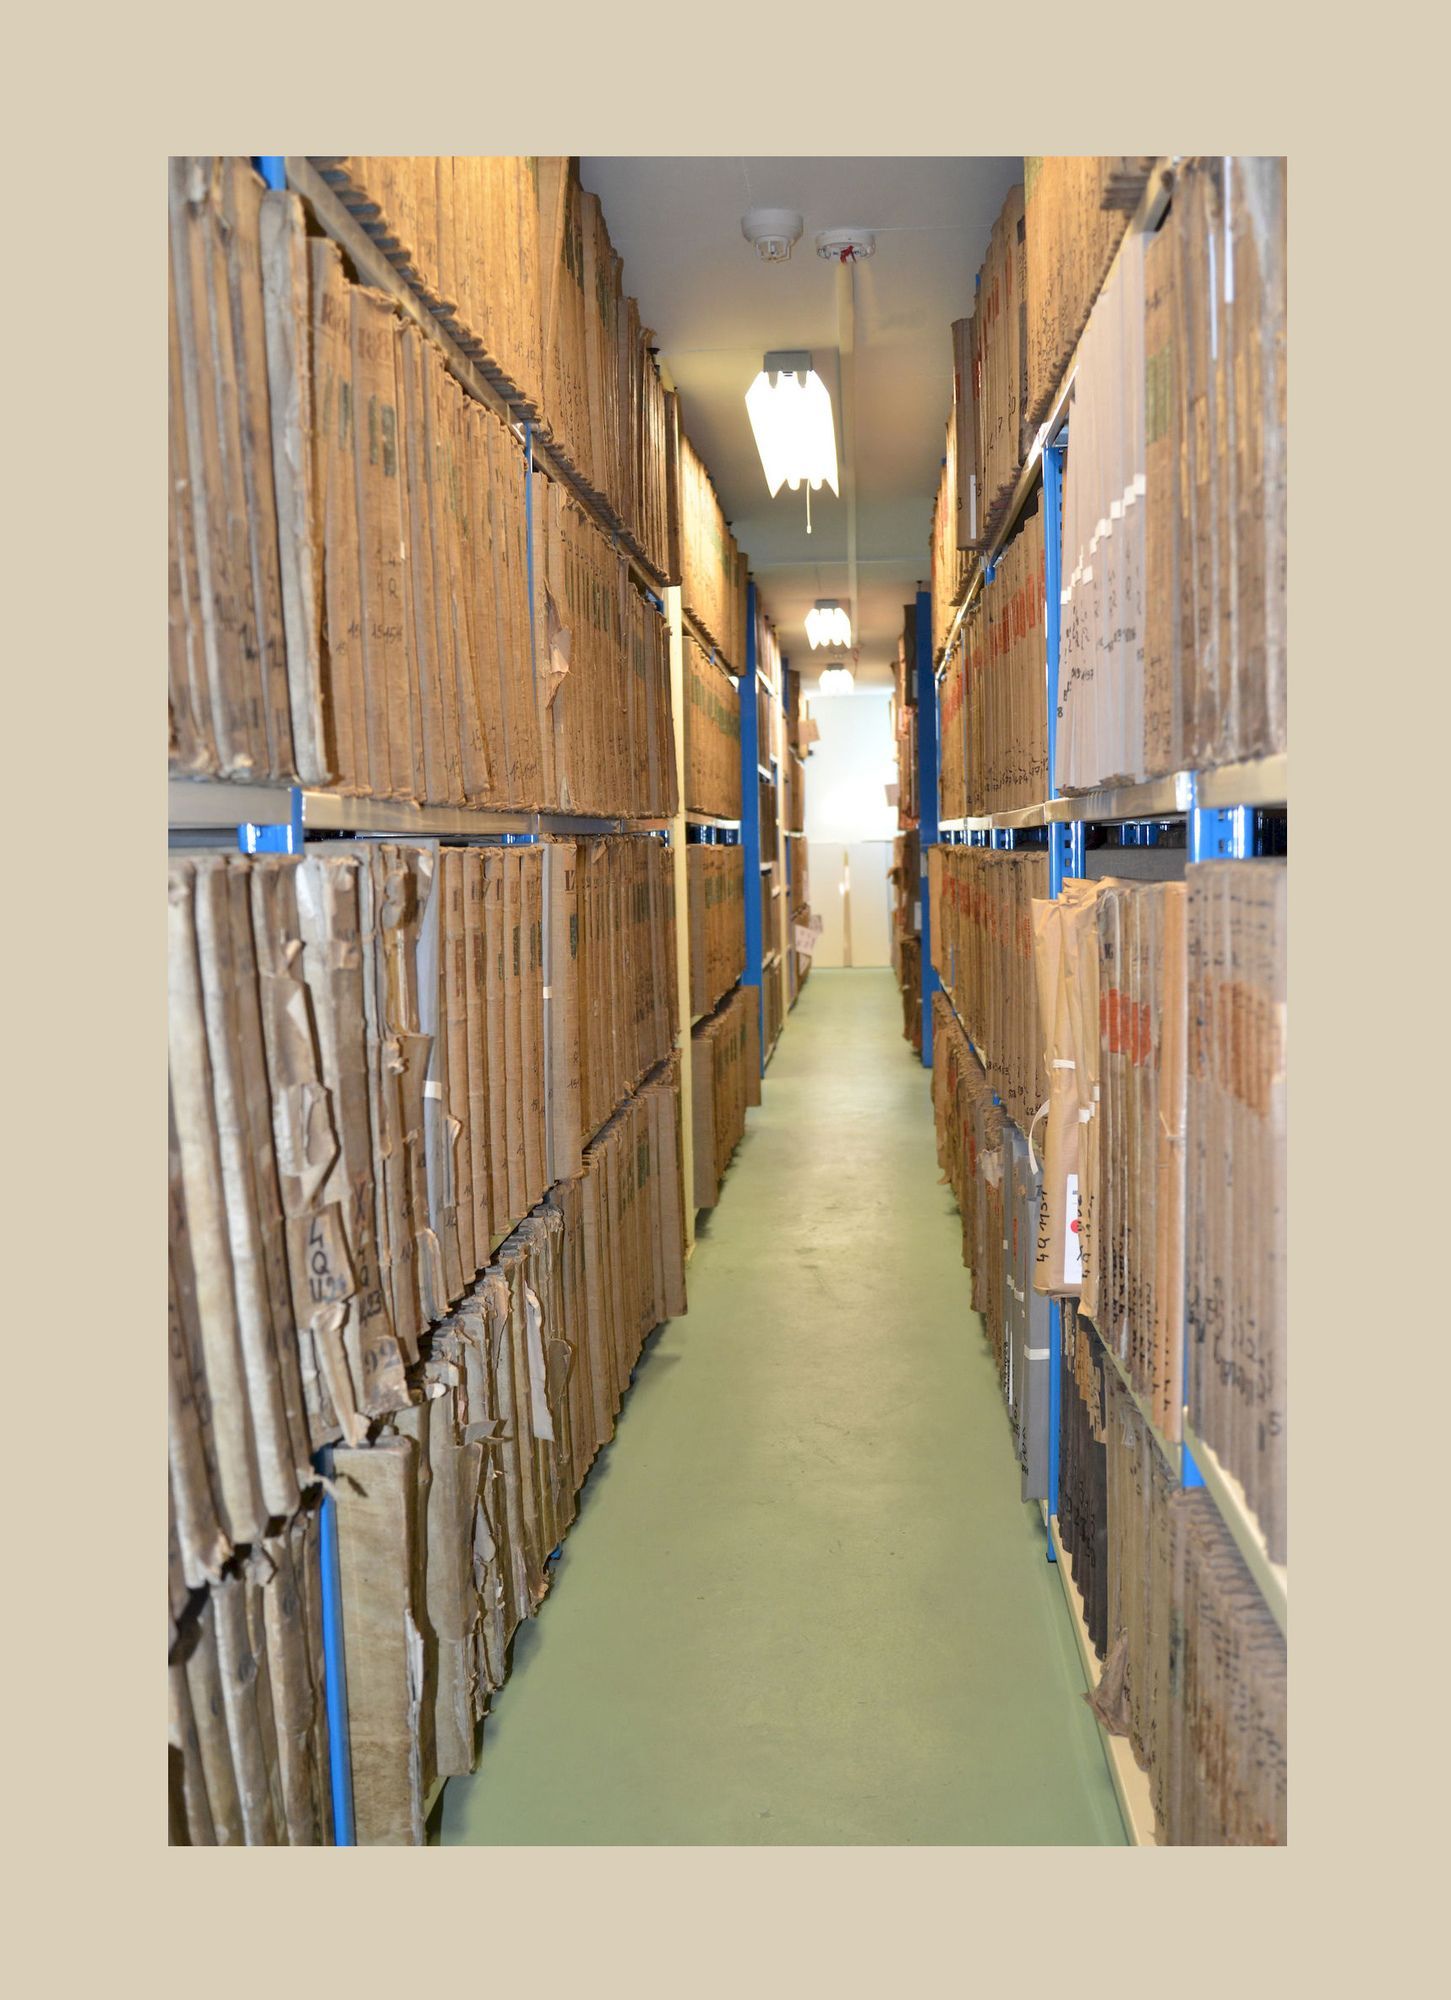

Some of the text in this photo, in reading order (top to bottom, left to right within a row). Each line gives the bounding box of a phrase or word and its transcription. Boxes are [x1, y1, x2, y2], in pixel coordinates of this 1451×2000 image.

[1037, 1237, 1051, 1249] Q
[311, 1251, 330, 1277] Q
[1036, 1253, 1049, 1263] 4
